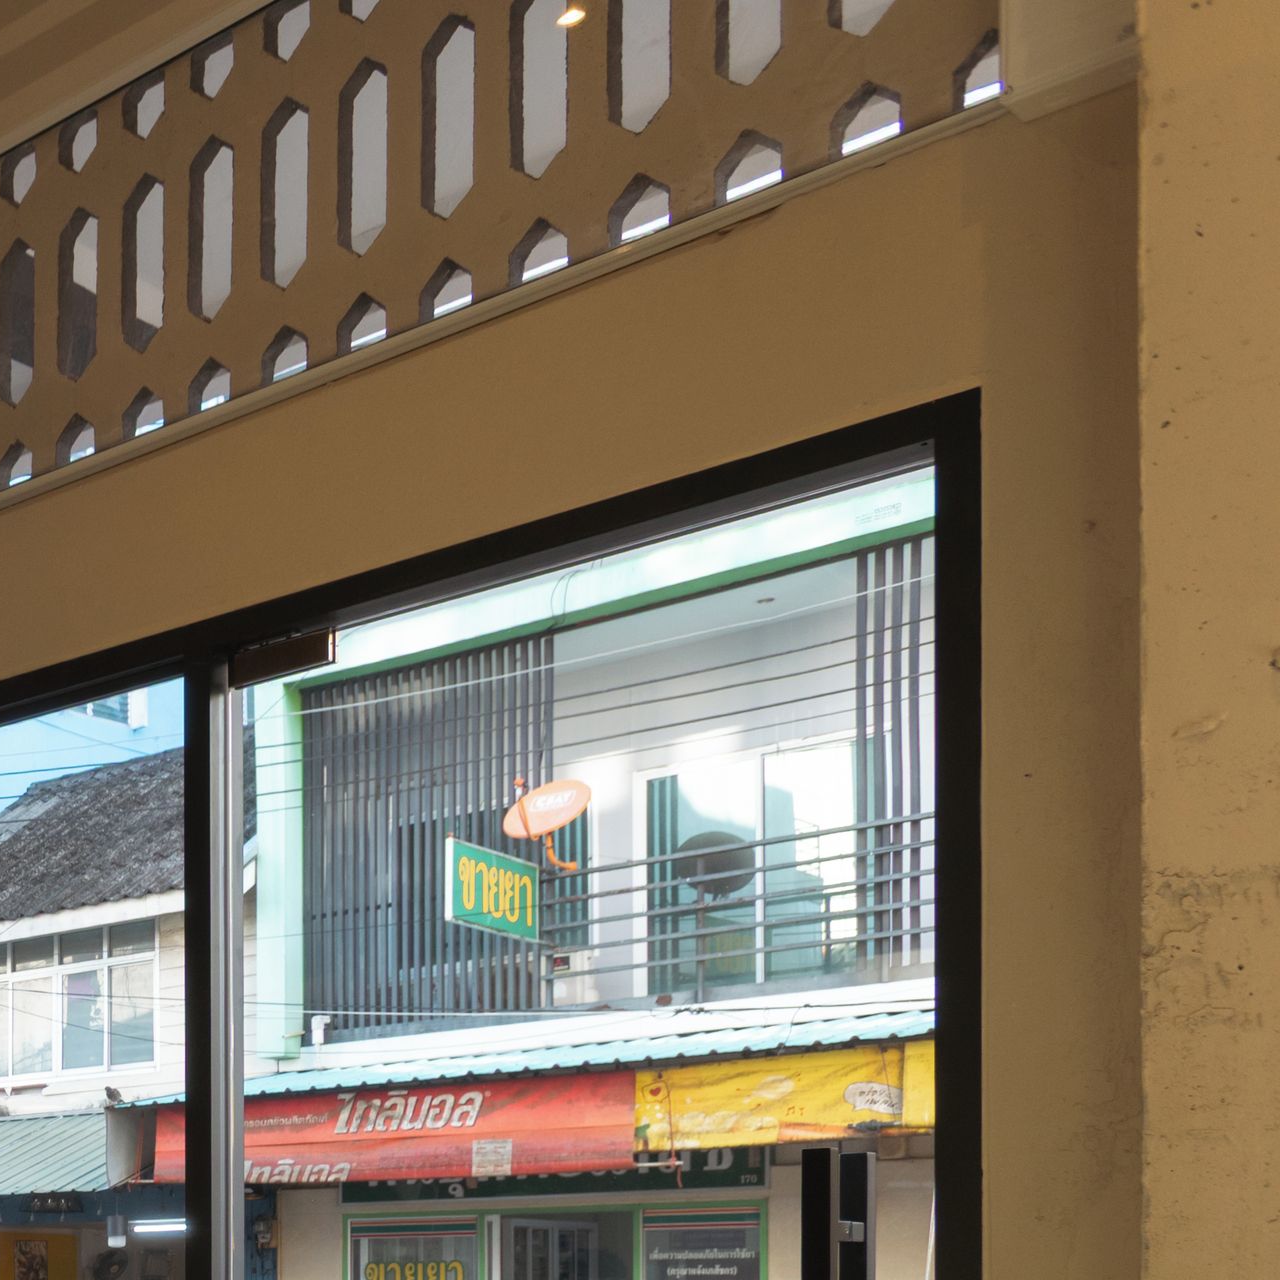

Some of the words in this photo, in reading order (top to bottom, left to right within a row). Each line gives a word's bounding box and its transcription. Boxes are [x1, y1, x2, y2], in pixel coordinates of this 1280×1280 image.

[458, 856, 533, 927] ขายยา
[334, 1089, 485, 1134] ไทลินอล
